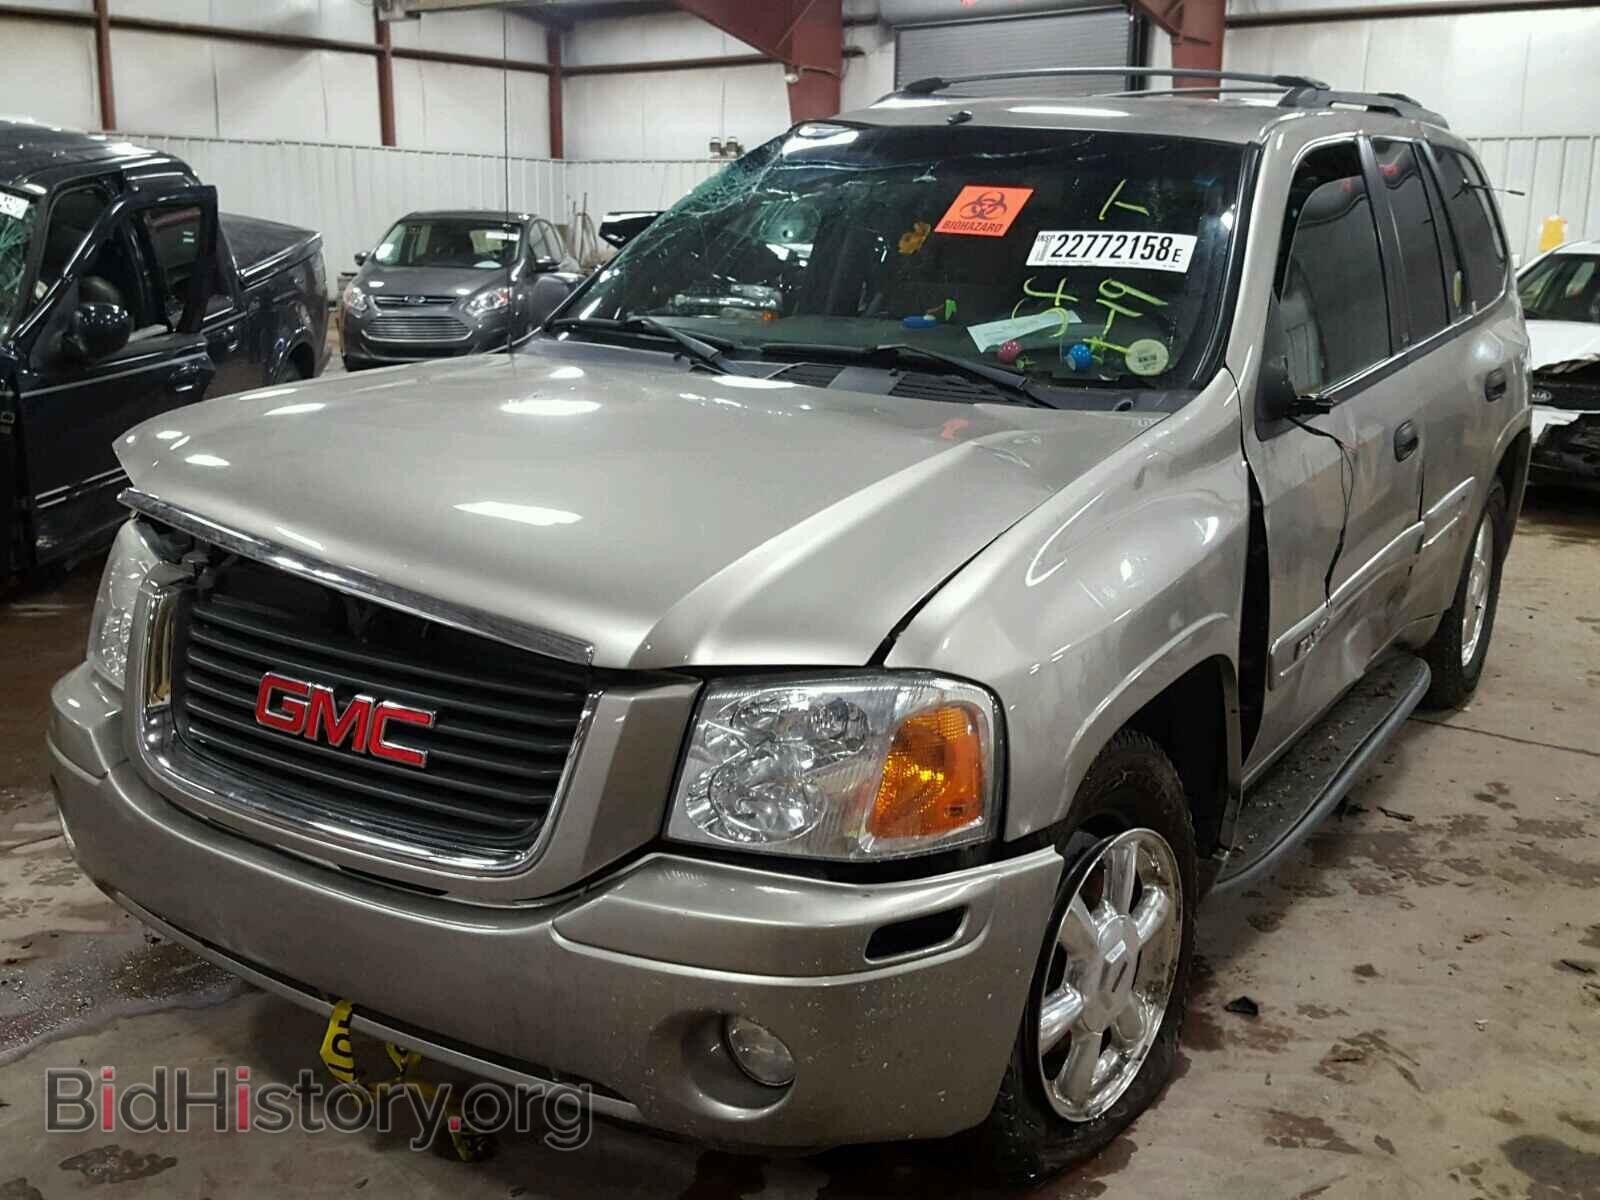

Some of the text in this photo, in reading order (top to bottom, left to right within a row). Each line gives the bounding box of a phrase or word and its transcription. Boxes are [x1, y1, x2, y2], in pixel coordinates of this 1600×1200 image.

[941, 219, 1004, 233] BIOHAZARD
[1050, 233, 1174, 262] 22772158
[1171, 248, 1184, 263] E
[255, 671, 437, 768] GMC
